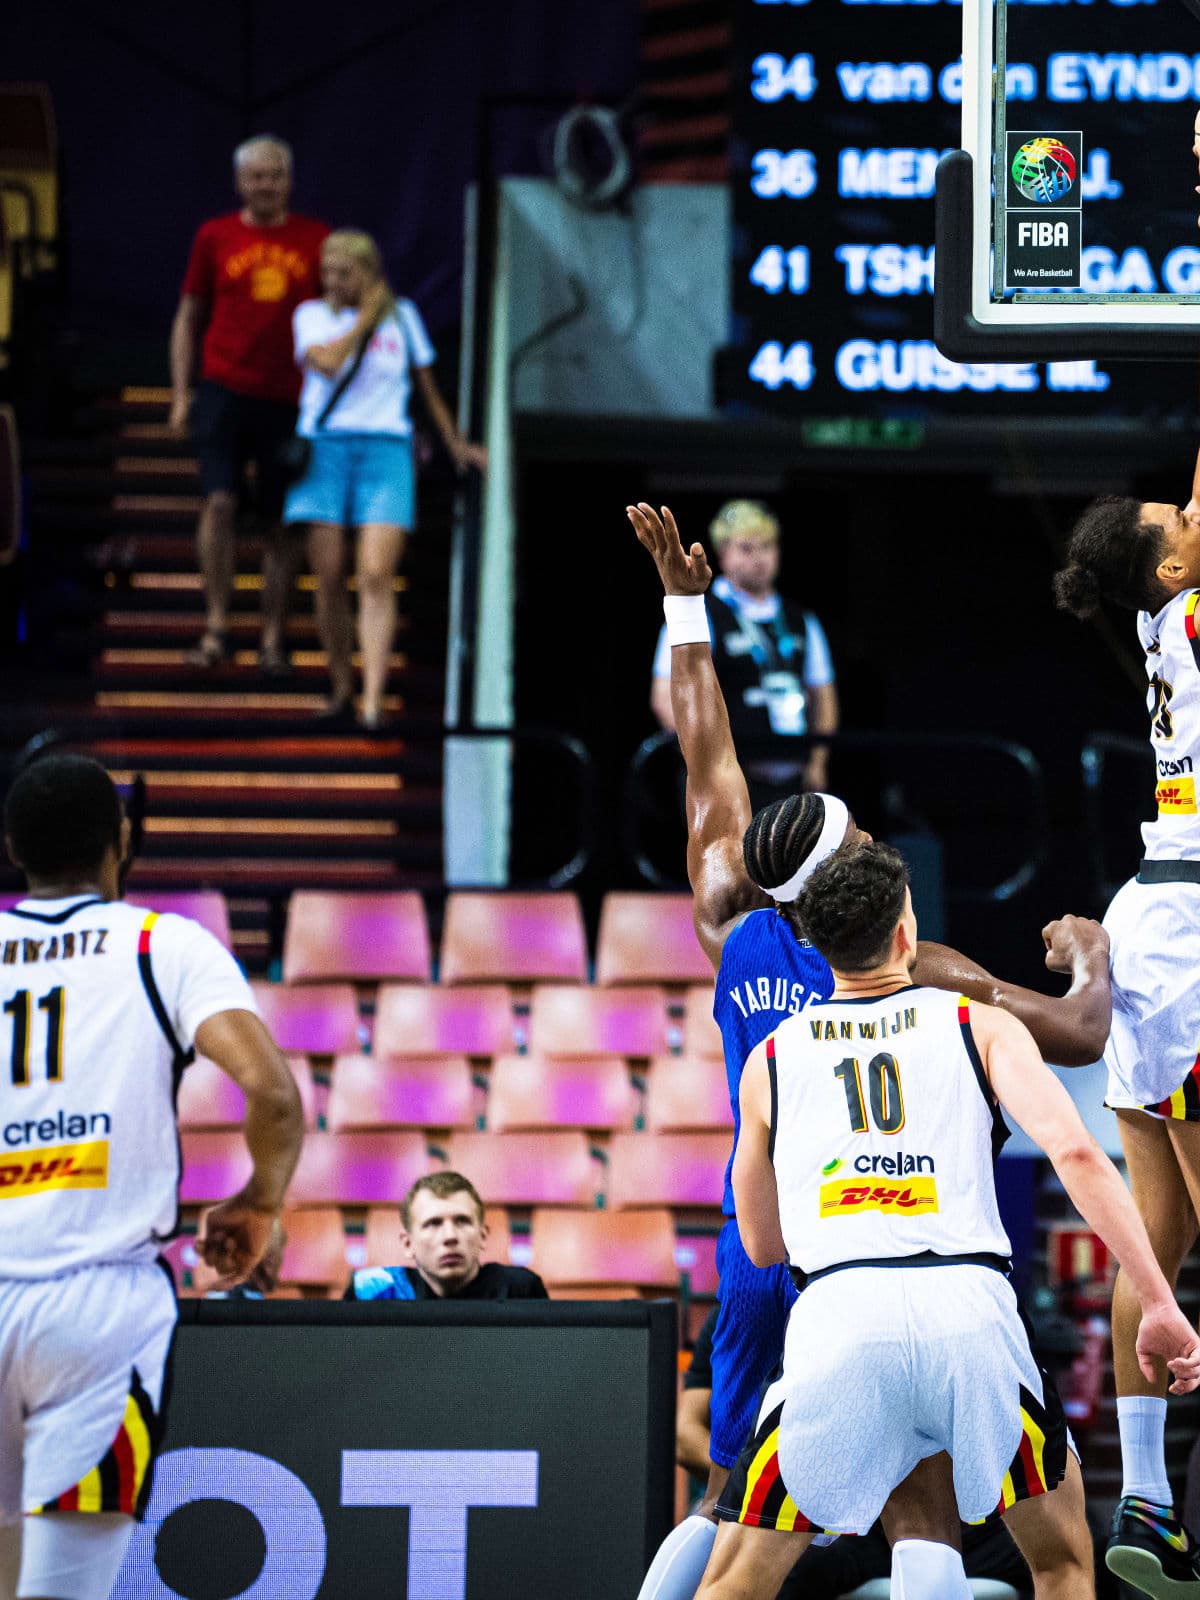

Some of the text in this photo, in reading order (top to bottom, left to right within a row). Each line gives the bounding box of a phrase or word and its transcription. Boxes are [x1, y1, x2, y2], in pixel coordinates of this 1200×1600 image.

[751, 52, 818, 103] 34
[836, 61, 932, 103] van
[938, 54, 1037, 103] dn
[751, 148, 818, 199] 36
[1018, 222, 1069, 247] FIBA
[750, 245, 811, 295] 41
[1013, 268, 1073, 277] We Are Basketball
[749, 340, 816, 391] 44
[0, 928, 109, 965] HWARTZ
[3, 985, 66, 1087] 11
[809, 1007, 918, 1041] VAN WIJN
[833, 1052, 906, 1134] 10
[4, 1110, 112, 1147] crelan
[854, 1152, 935, 1177] crelan
[838, 1186, 918, 1207] DHL
